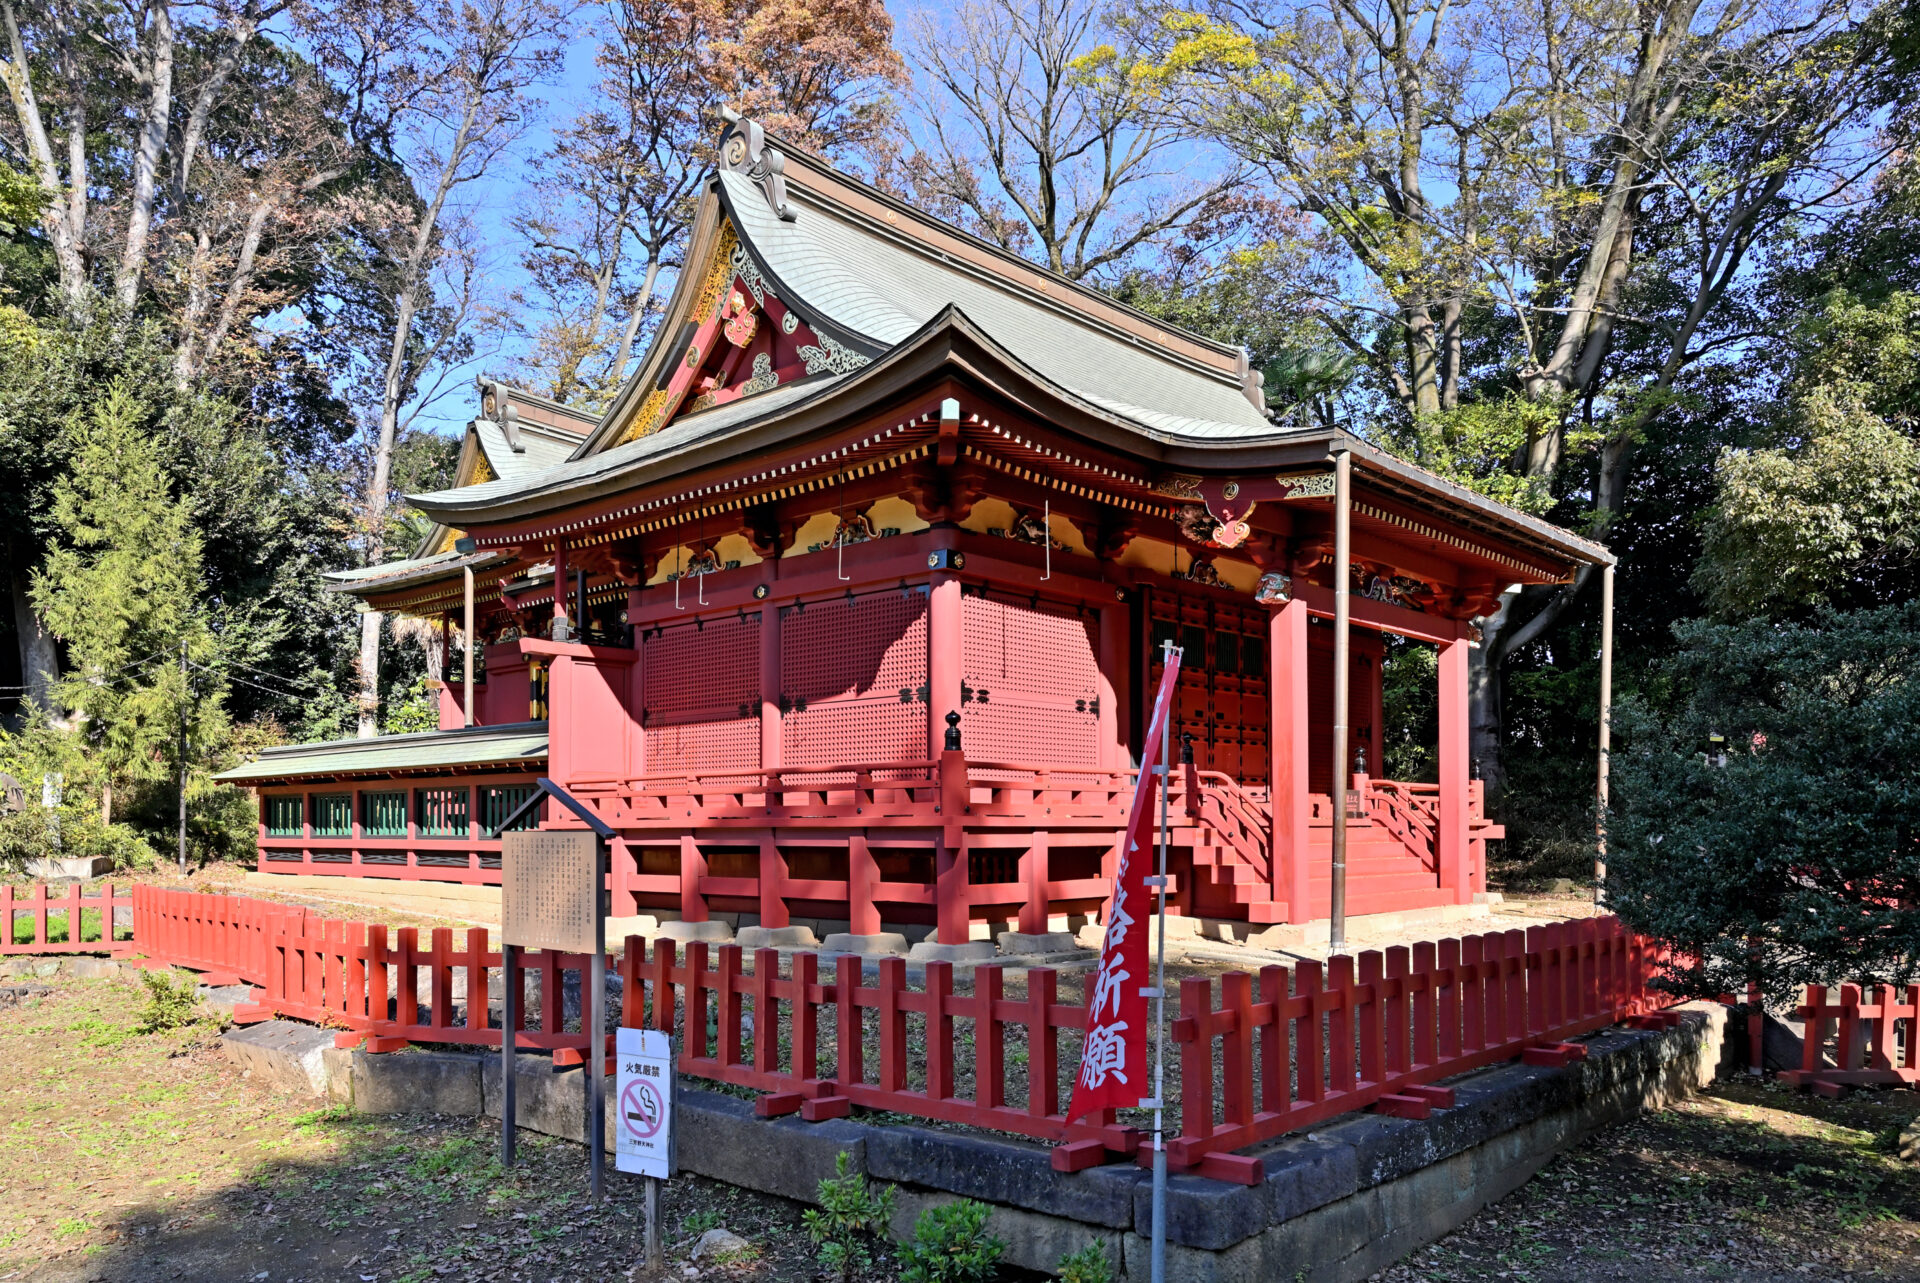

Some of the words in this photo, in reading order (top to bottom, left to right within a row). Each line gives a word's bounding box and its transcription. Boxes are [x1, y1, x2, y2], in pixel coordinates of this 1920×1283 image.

[1080, 839, 1140, 1091] 格祈願
[624, 1061, 660, 1078] 火気厳禁
